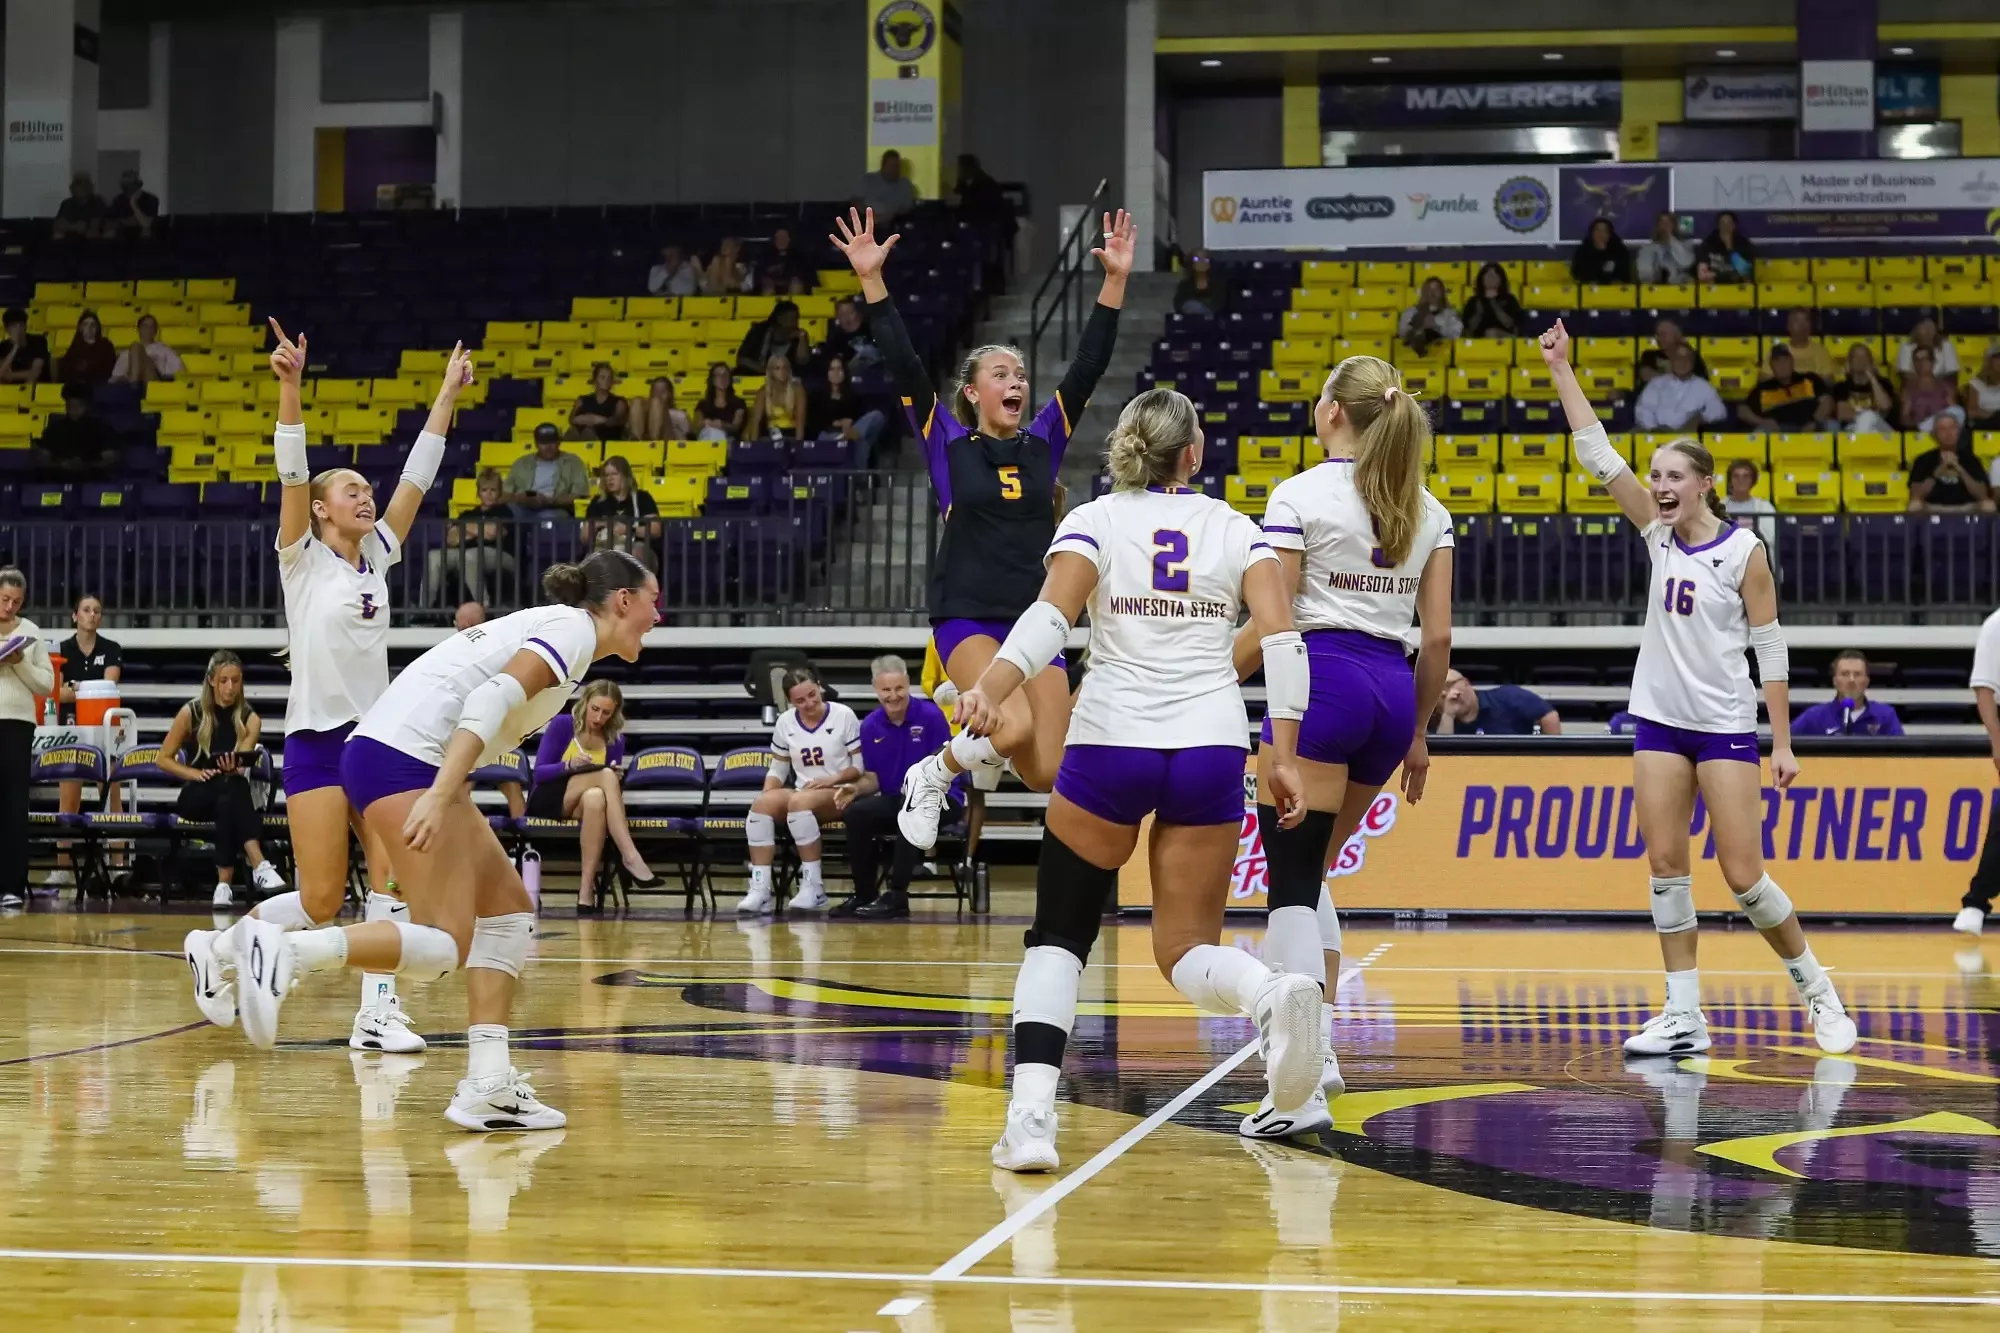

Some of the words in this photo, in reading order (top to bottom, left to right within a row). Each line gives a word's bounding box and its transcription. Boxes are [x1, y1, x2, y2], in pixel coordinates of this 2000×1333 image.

[1406, 84, 1598, 110] MAVERICK
[1820, 84, 1869, 98] Hilton
[887, 101, 933, 113] Hilton
[22, 119, 63, 133] Hilton
[1713, 173, 1796, 206] MBA
[1802, 174, 1850, 187] Master
[1853, 174, 1868, 187] of
[1872, 174, 1937, 187] Business
[1240, 196, 1293, 210] Auntie
[1417, 192, 1480, 220] jamba
[1802, 191, 1907, 203] Administration
[1240, 211, 1294, 224] Anne's
[998, 466, 1022, 500] 5
[1152, 528, 1191, 593] 2
[1329, 571, 1394, 594] MINNESOTA
[1664, 577, 1696, 616] 16
[1110, 596, 1185, 618] MINNESOTA
[1190, 601, 1227, 618] STATE
[77, 750, 97, 768] STATE
[676, 752, 696, 771] STATE
[800, 746, 825, 767] 22
[92, 815, 142, 823] MAVERICKS
[704, 820, 745, 828] MAVERIC
[1456, 785, 1647, 860] PROUD
